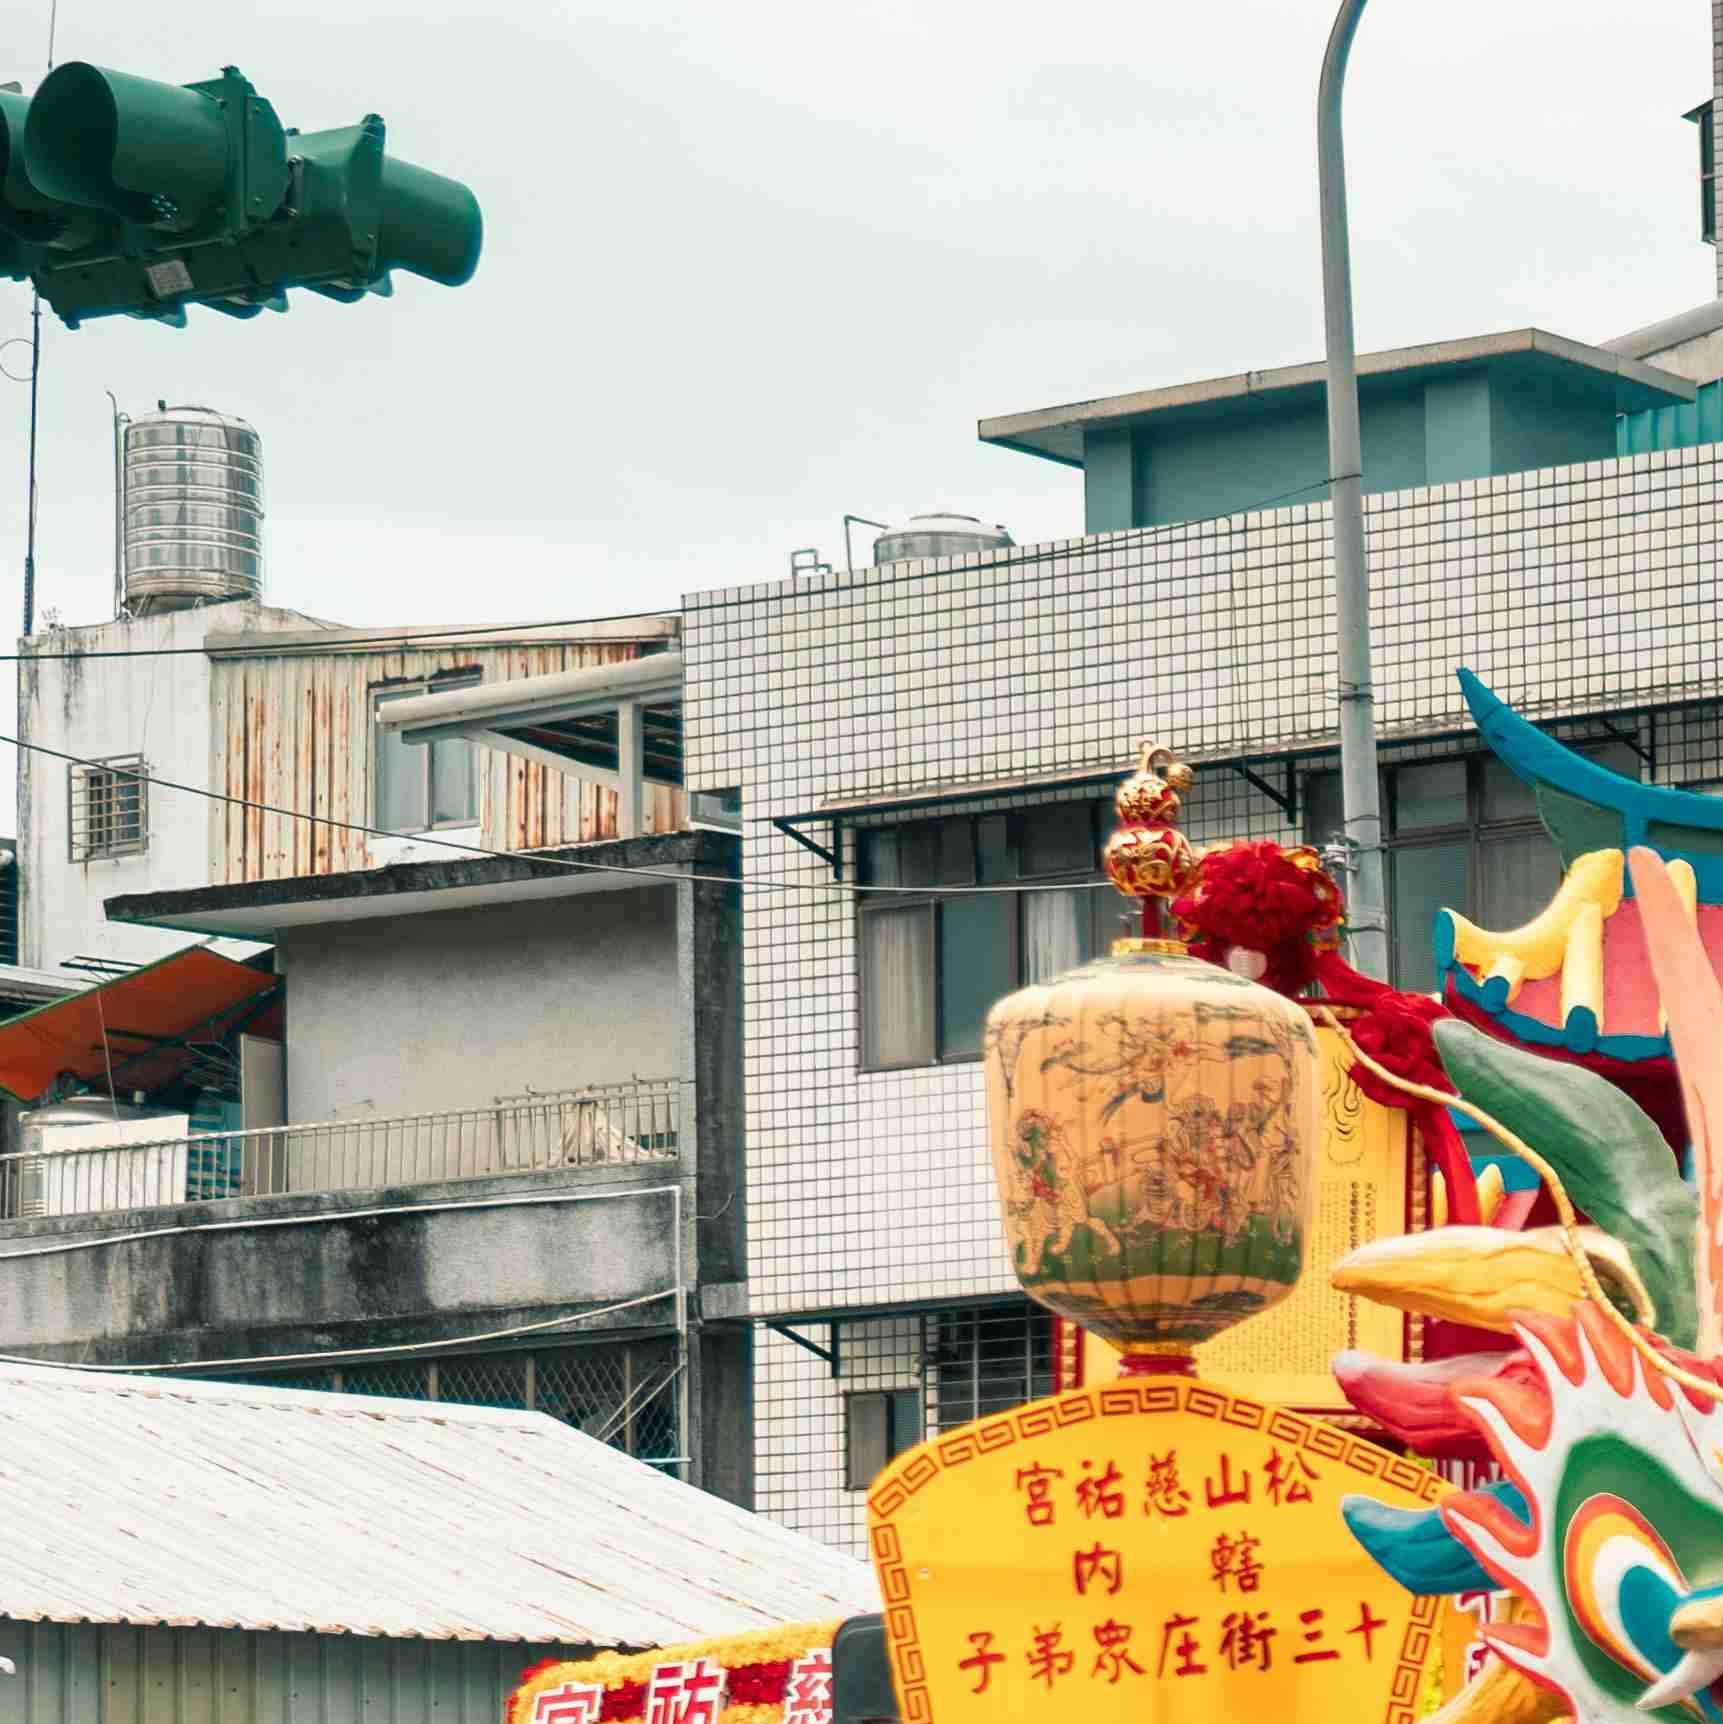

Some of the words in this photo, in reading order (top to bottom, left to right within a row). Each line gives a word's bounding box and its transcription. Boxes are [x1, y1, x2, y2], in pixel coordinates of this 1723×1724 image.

[1015, 1446, 1321, 1527] 松山慈祐宮
